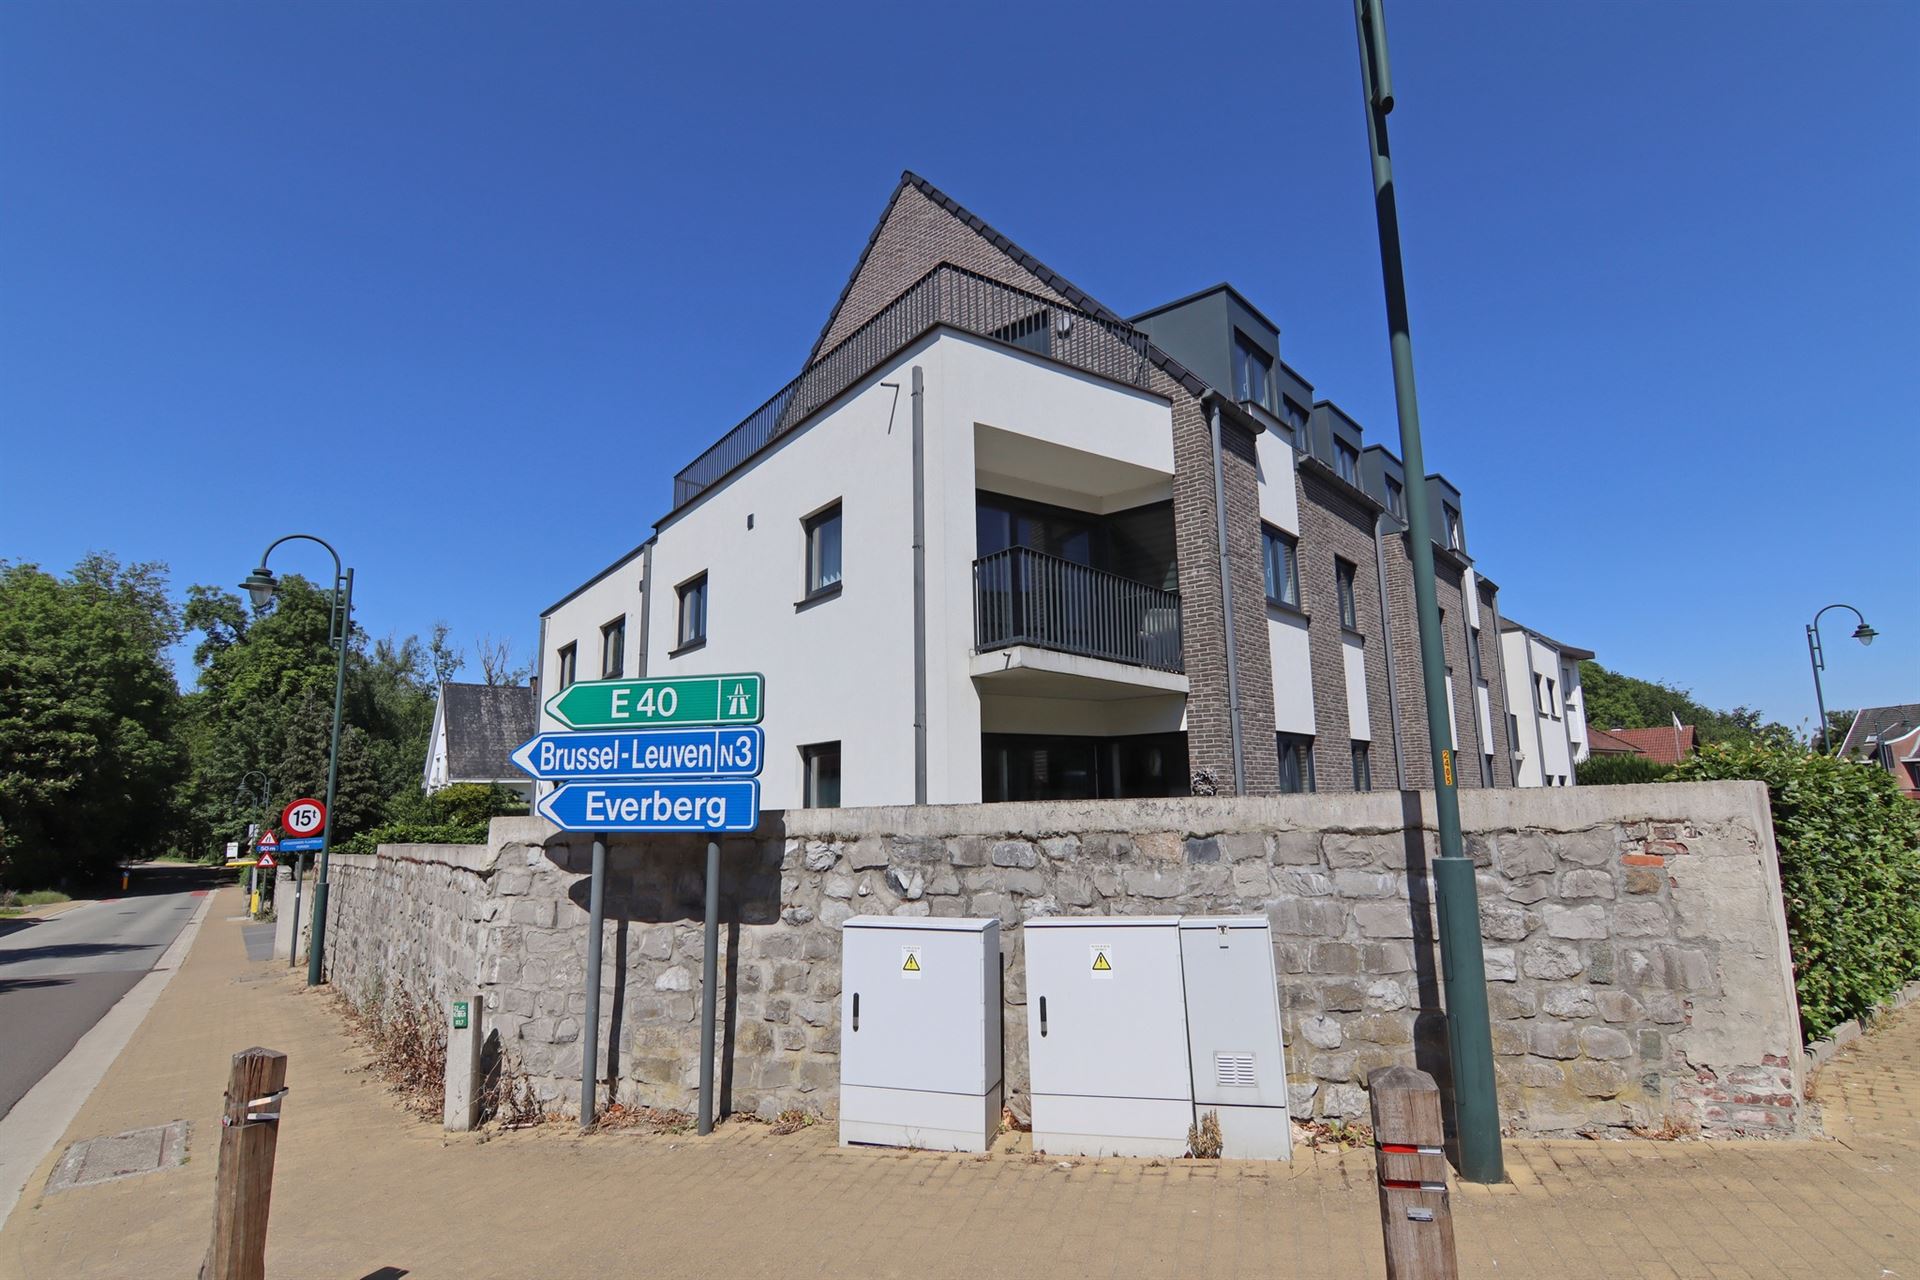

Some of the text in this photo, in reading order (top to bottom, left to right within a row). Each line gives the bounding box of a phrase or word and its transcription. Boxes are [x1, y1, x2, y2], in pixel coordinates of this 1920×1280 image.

[611, 687, 678, 718] E 40
[720, 736, 752, 767] N3
[586, 790, 726, 828] Everberg
